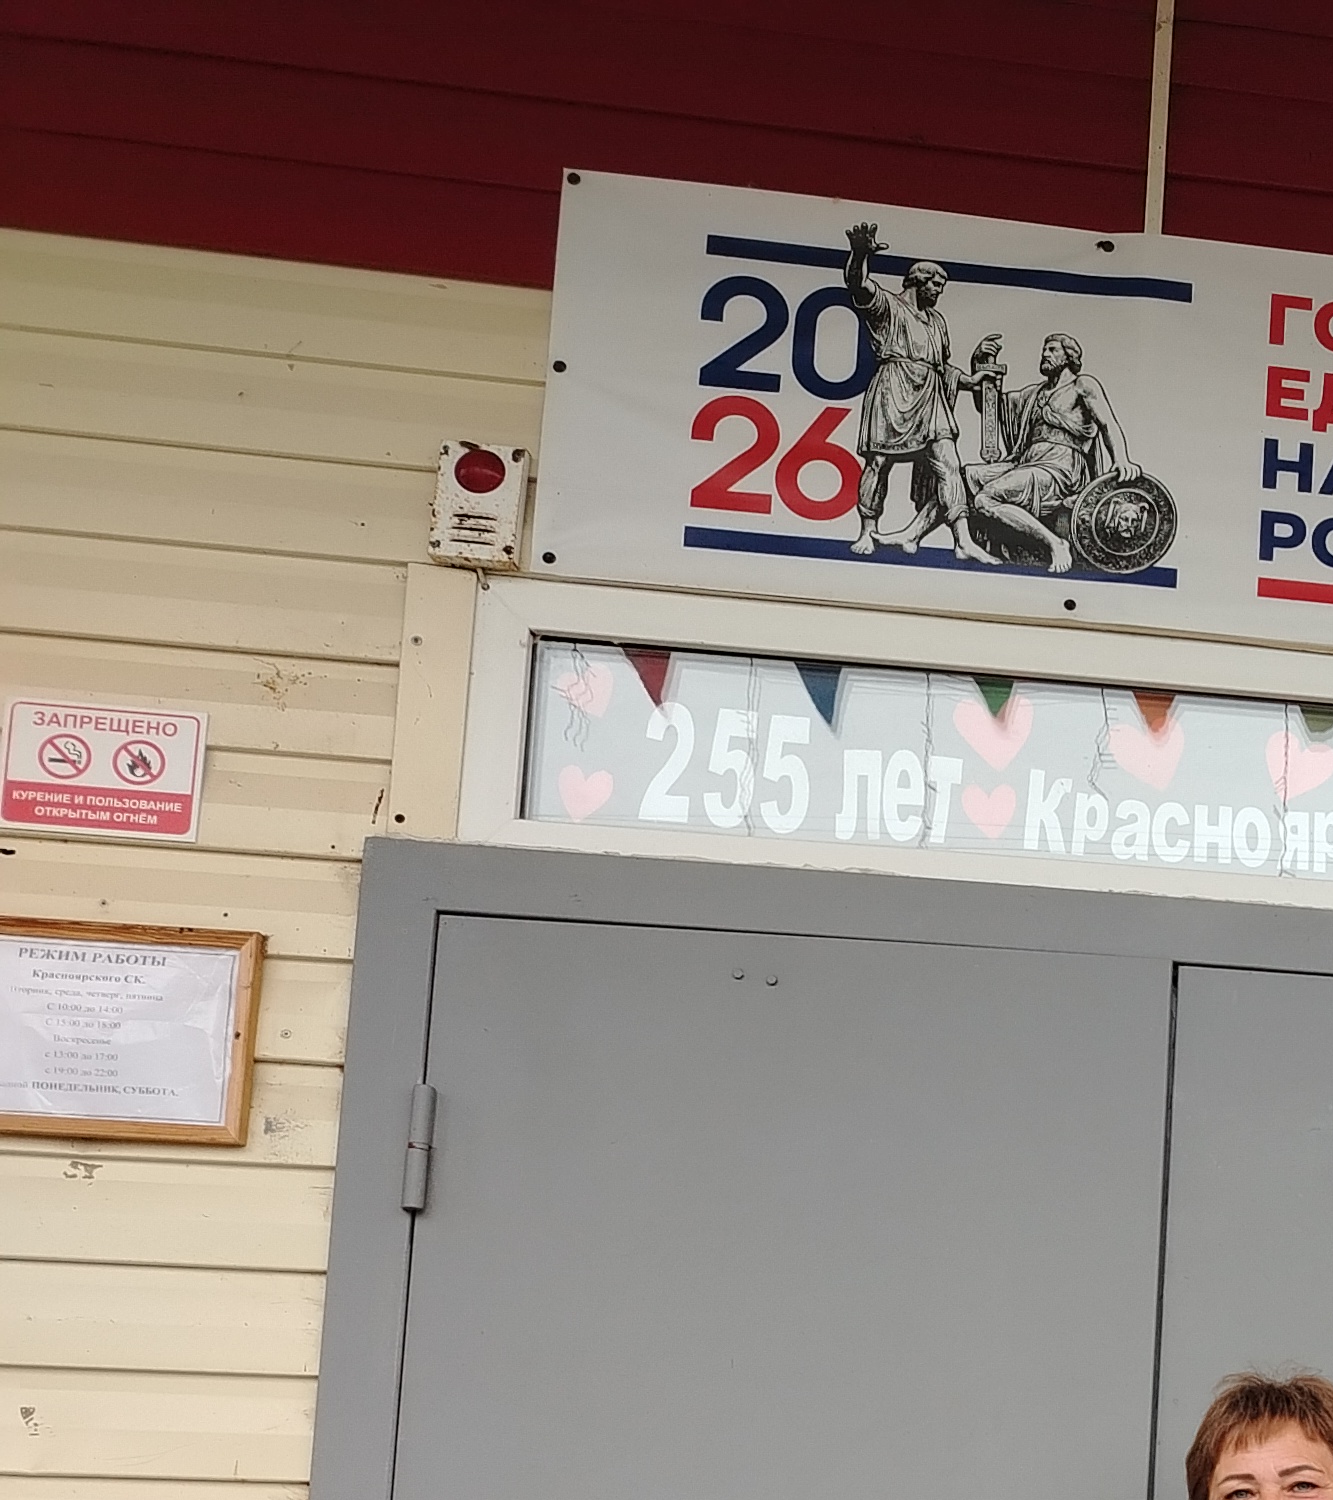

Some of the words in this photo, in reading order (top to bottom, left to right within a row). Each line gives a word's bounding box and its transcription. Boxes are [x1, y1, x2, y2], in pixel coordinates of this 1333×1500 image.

[699, 275, 876, 400] 20
[690, 395, 863, 522] 26
[32, 711, 178, 737] ЗАПРЕЩЕНО
[638, 701, 811, 834] 255
[835, 748, 963, 843] лет
[12, 790, 71, 804] КУРЕНИЕ
[74, 794, 84, 804] И
[87, 795, 182, 813] ПОЛЬЗОВАНИЕ
[34, 807, 110, 821] ОТКРЫТЫМ
[113, 811, 158, 825] ОГНЁМ
[18, 947, 86, 962] РЕЖИМ
[92, 953, 167, 967] РАБОТЫ
[32, 969, 121, 983] Красноярского
[124, 975, 147, 985] СК.
[57, 1003, 82, 1012] 10:00
[98, 1005, 123, 1014] 14:00
[53, 1050, 79, 1059] 13:00
[95, 1052, 118, 1061] 17:00
[94, 1068, 118, 1078] 22:00
[32, 1081, 121, 1094] ПОНЕДЕЛЬНИК,
[123, 1087, 179, 1097] СУББОТА.
